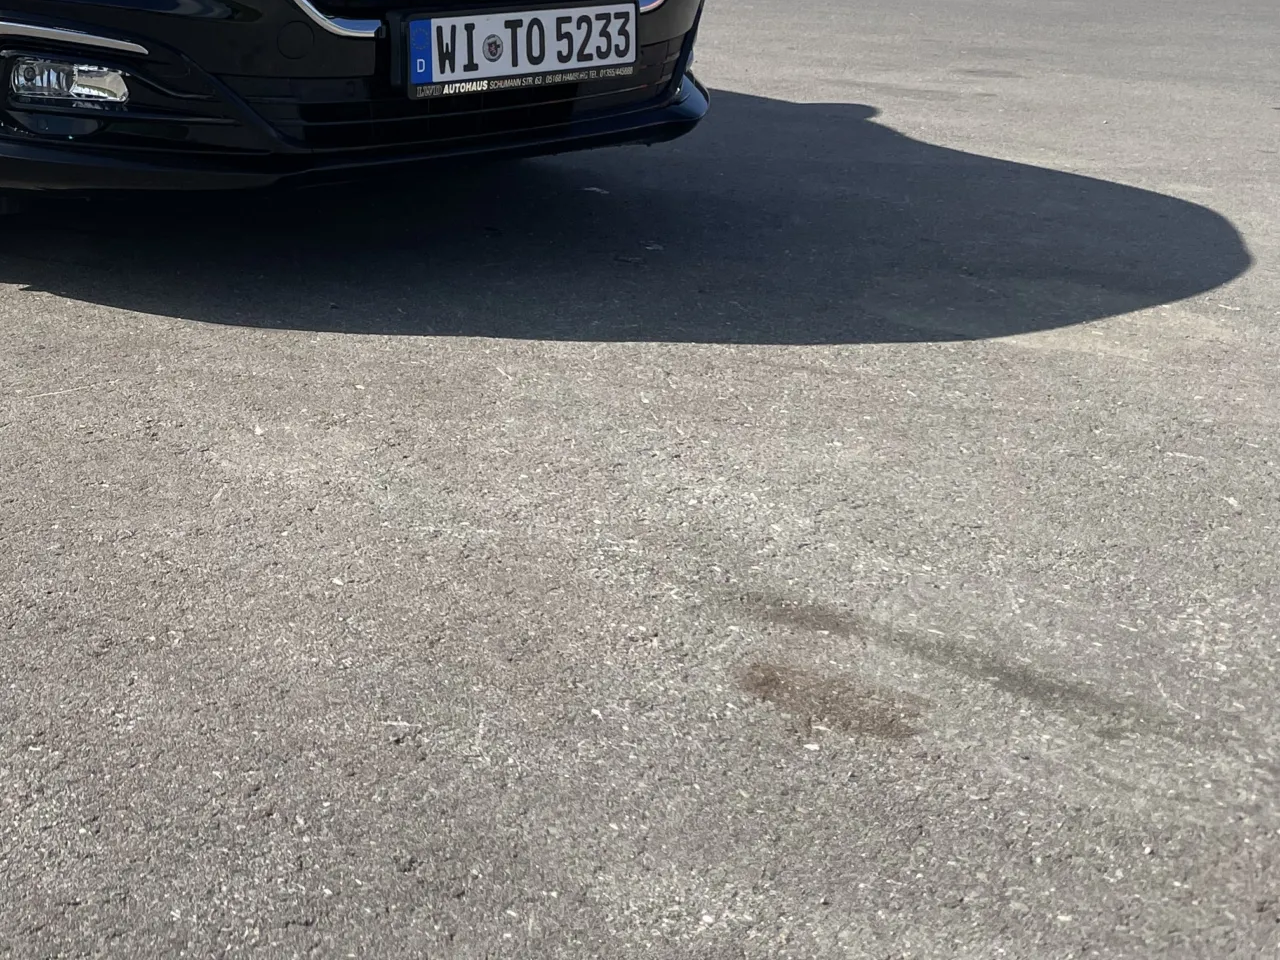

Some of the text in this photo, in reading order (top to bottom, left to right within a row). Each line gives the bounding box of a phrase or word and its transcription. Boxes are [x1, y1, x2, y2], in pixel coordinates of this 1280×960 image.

[436, 11, 630, 74] WI TO 5233
[416, 58, 426, 73] D
[443, 80, 488, 95] AUTOHAUS
